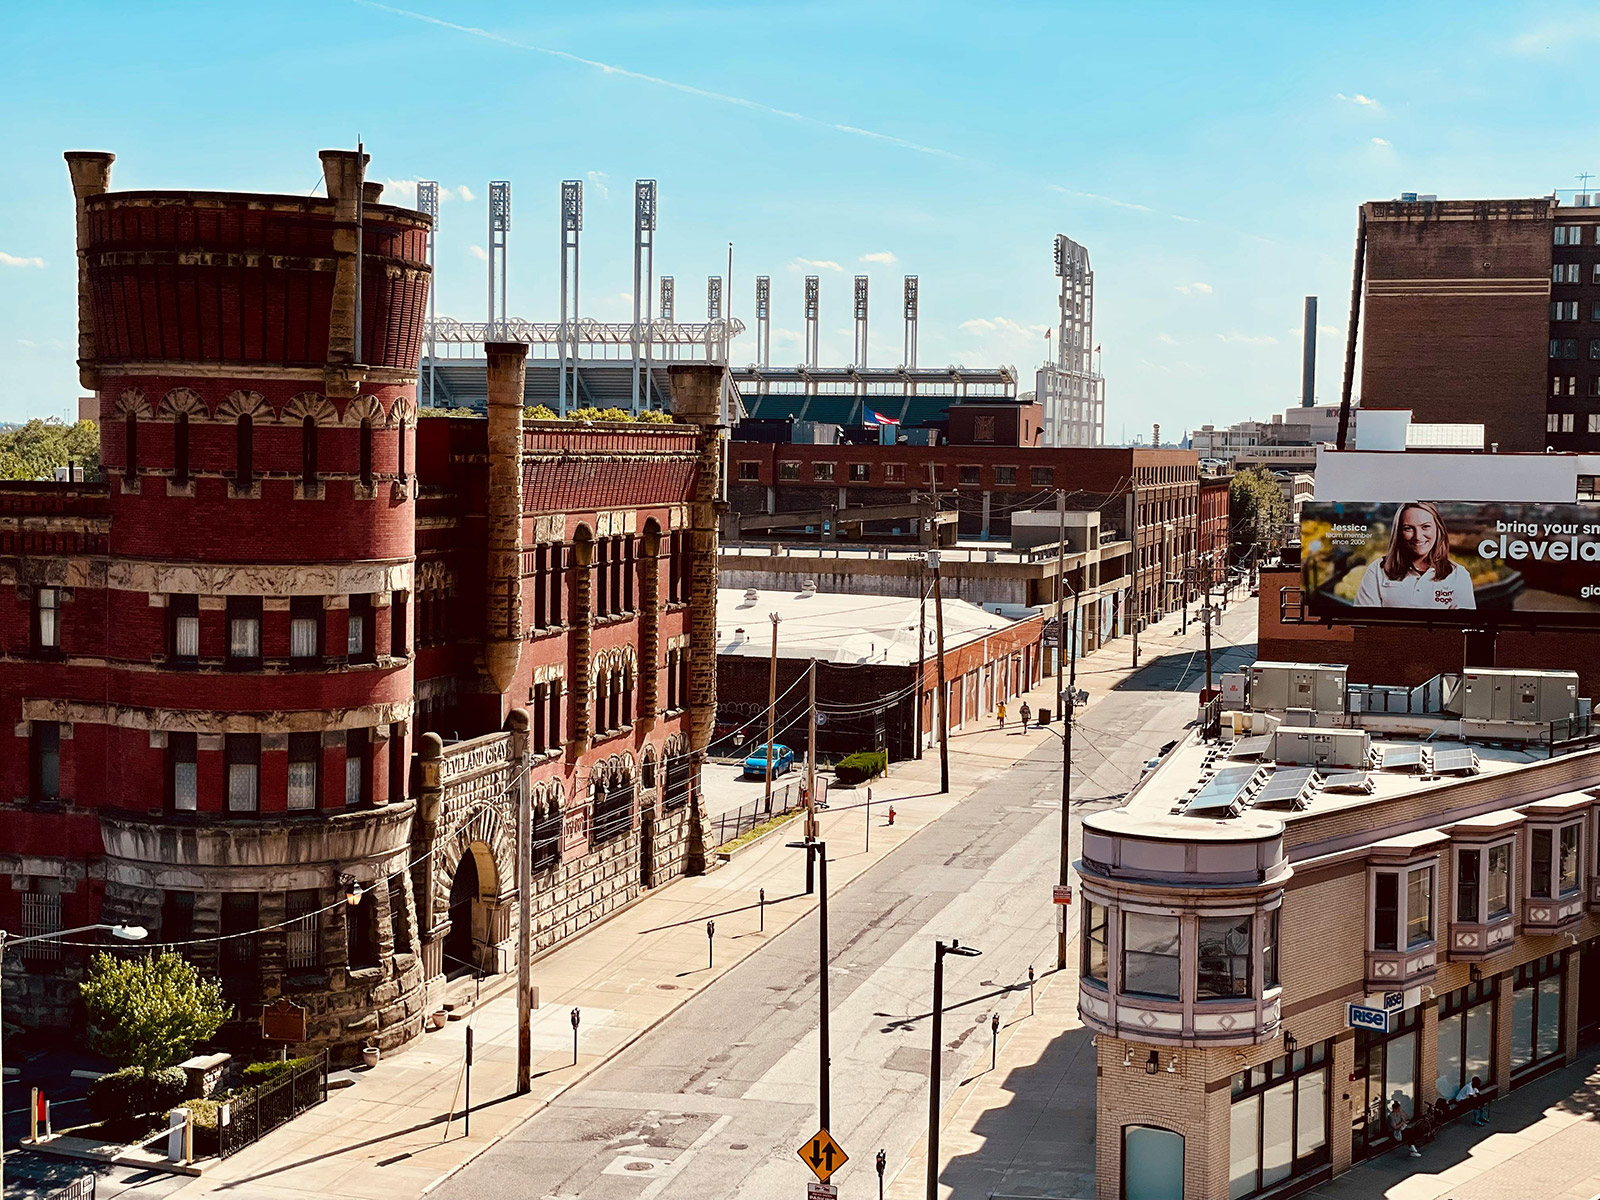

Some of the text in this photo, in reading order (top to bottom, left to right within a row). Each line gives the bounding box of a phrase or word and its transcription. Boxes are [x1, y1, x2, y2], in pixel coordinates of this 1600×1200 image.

[1331, 523, 1367, 532] Jessica
[1496, 520, 1538, 537] bring
[1543, 523, 1579, 537] your
[1478, 535, 1600, 562] clevela
[486, 740, 513, 764] GRAYS
